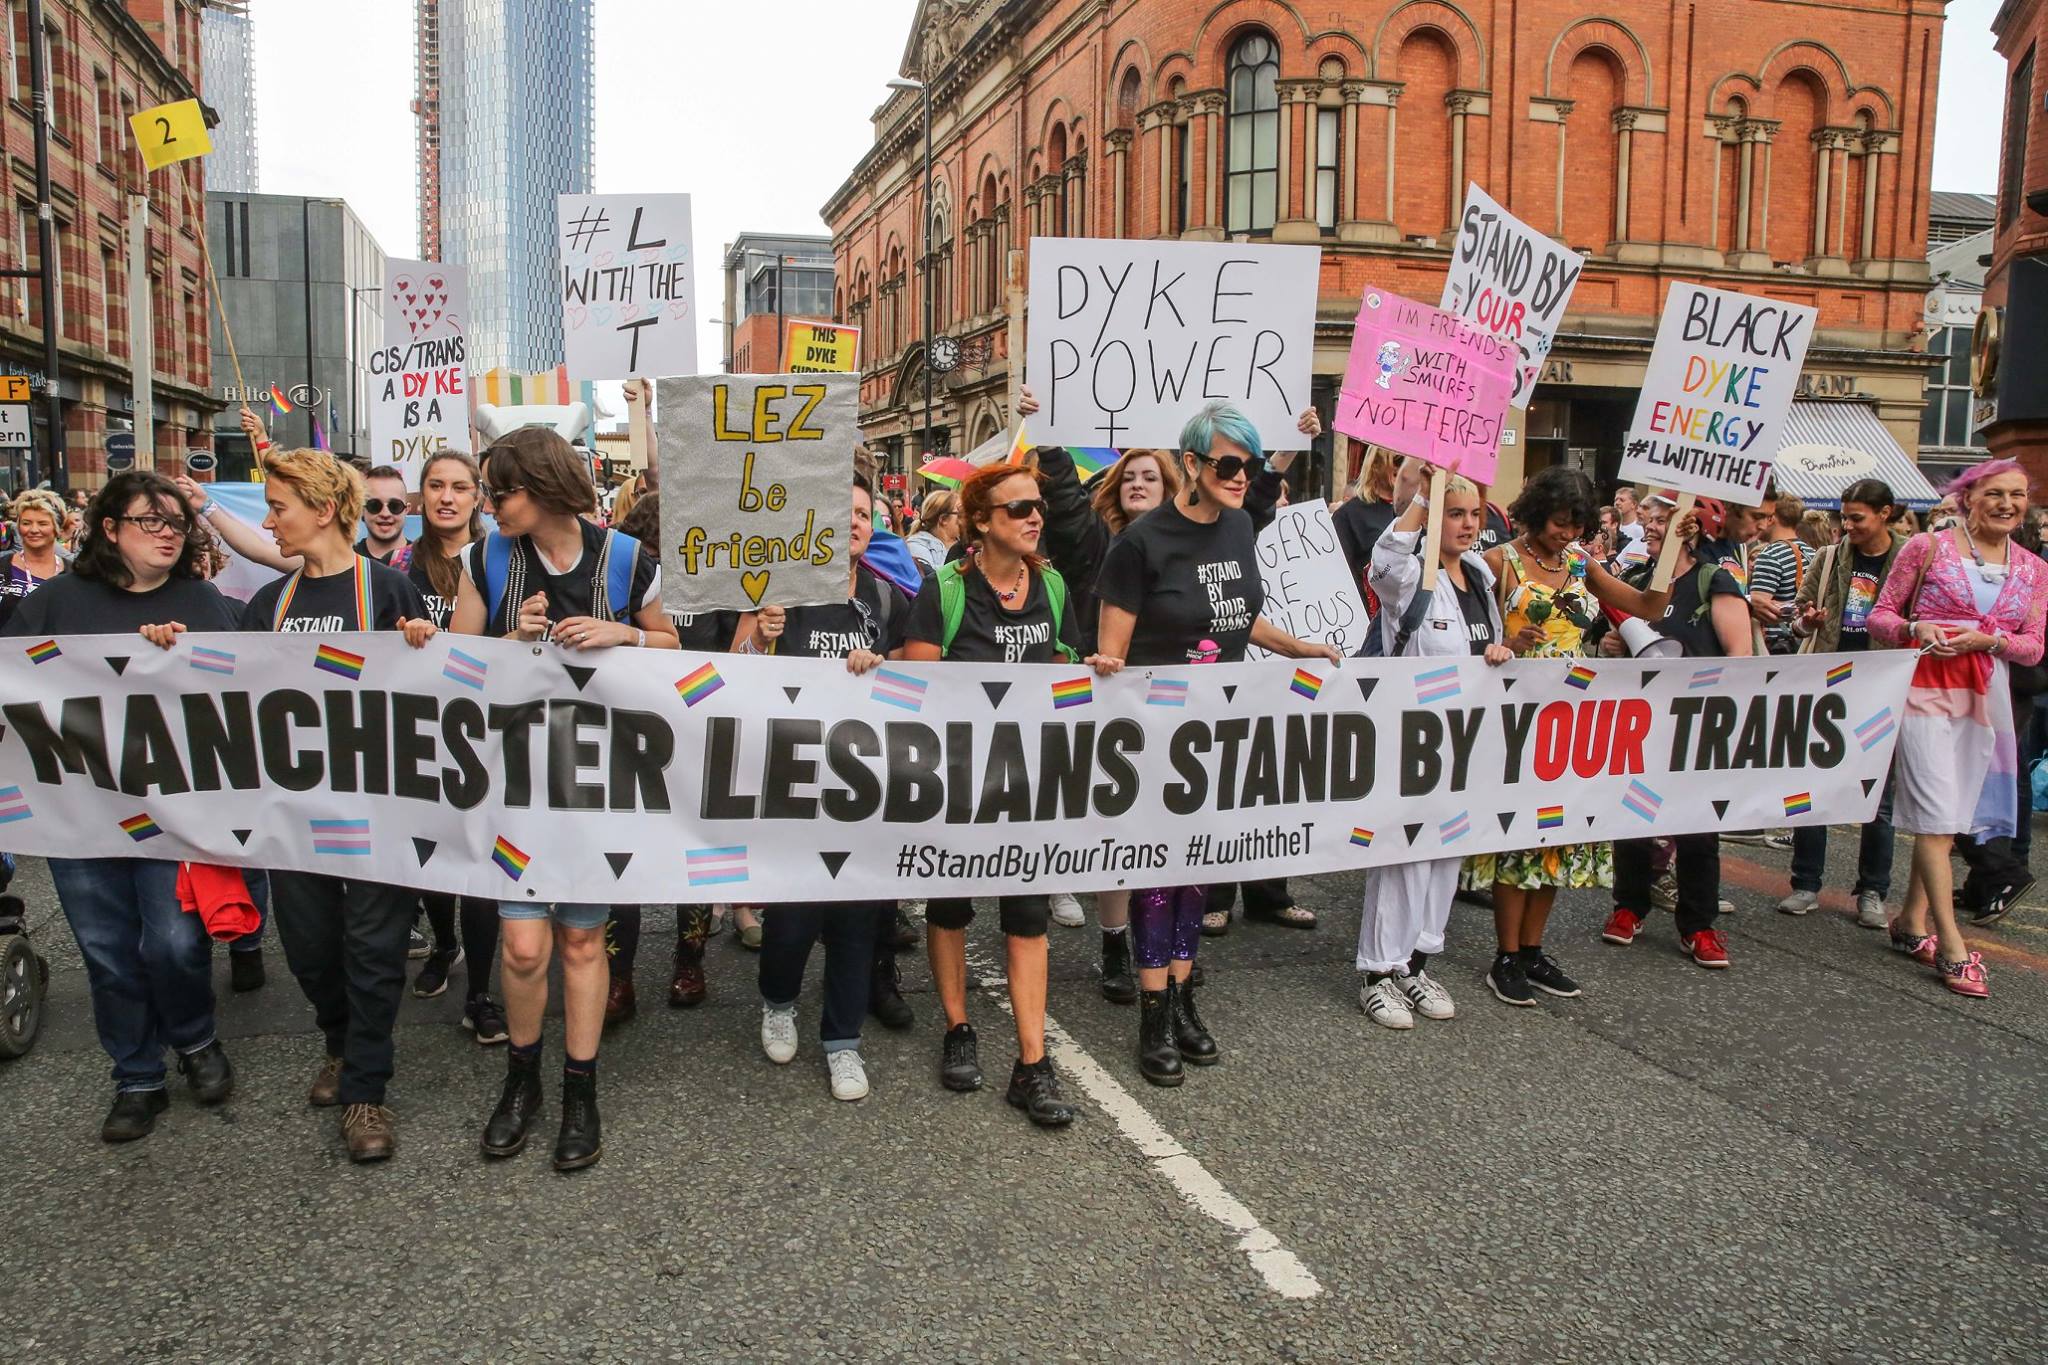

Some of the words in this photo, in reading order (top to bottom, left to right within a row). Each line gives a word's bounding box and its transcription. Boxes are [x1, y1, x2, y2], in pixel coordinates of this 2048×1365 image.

[155, 117, 177, 145] 2
[565, 264, 635, 305] WITH
[638, 262, 685, 301] THE
[1461, 205, 1533, 297] STAND
[1531, 252, 1580, 321] BY
[1057, 259, 1260, 358] DYKE
[1462, 272, 1526, 339] YOUR
[1682, 291, 1804, 362] BLACK
[370, 336, 465, 375] CIS/TRANS
[616, 316, 659, 372] T
[806, 346, 837, 364] DYKE
[811, 326, 837, 343] THIS
[1430, 312, 1508, 362] FRIENDS
[382, 378, 395, 402] A
[402, 367, 463, 398] DYKE
[1049, 330, 1293, 431] POWER
[1403, 366, 1477, 402] SMURFS
[1414, 348, 1468, 379] WITH
[1537, 359, 1573, 382] AR
[1682, 355, 1769, 408] DYKE
[403, 401, 420, 428] IS
[427, 399, 442, 423] A
[712, 383, 826, 443] LEZ
[1355, 396, 1417, 432] NOT
[1423, 402, 1504, 458] TERFS!
[1649, 401, 1764, 452] ENERGY
[738, 451, 788, 512] be
[1625, 437, 1773, 491] #LWITHTHET
[678, 508, 835, 575] friends
[1197, 561, 1242, 584] #STAND
[1207, 582, 1224, 602] BY
[281, 615, 345, 632] #STAND
[1209, 612, 1252, 632] TRANS
[1210, 598, 1246, 618] YOUR
[993, 622, 1050, 644] #STAND
[1005, 644, 1027, 663] BY
[5, 688, 676, 814] MANCHESTER
[700, 716, 1146, 824] LESBIANS
[1162, 712, 1377, 816] STAND
[1400, 706, 1486, 799] BY
[1500, 697, 1653, 784] YOUR
[1669, 692, 1848, 773] TRANS
[896, 838, 1169, 881] #StandByYourTrans
[1186, 823, 1314, 868] #LwiththeT
